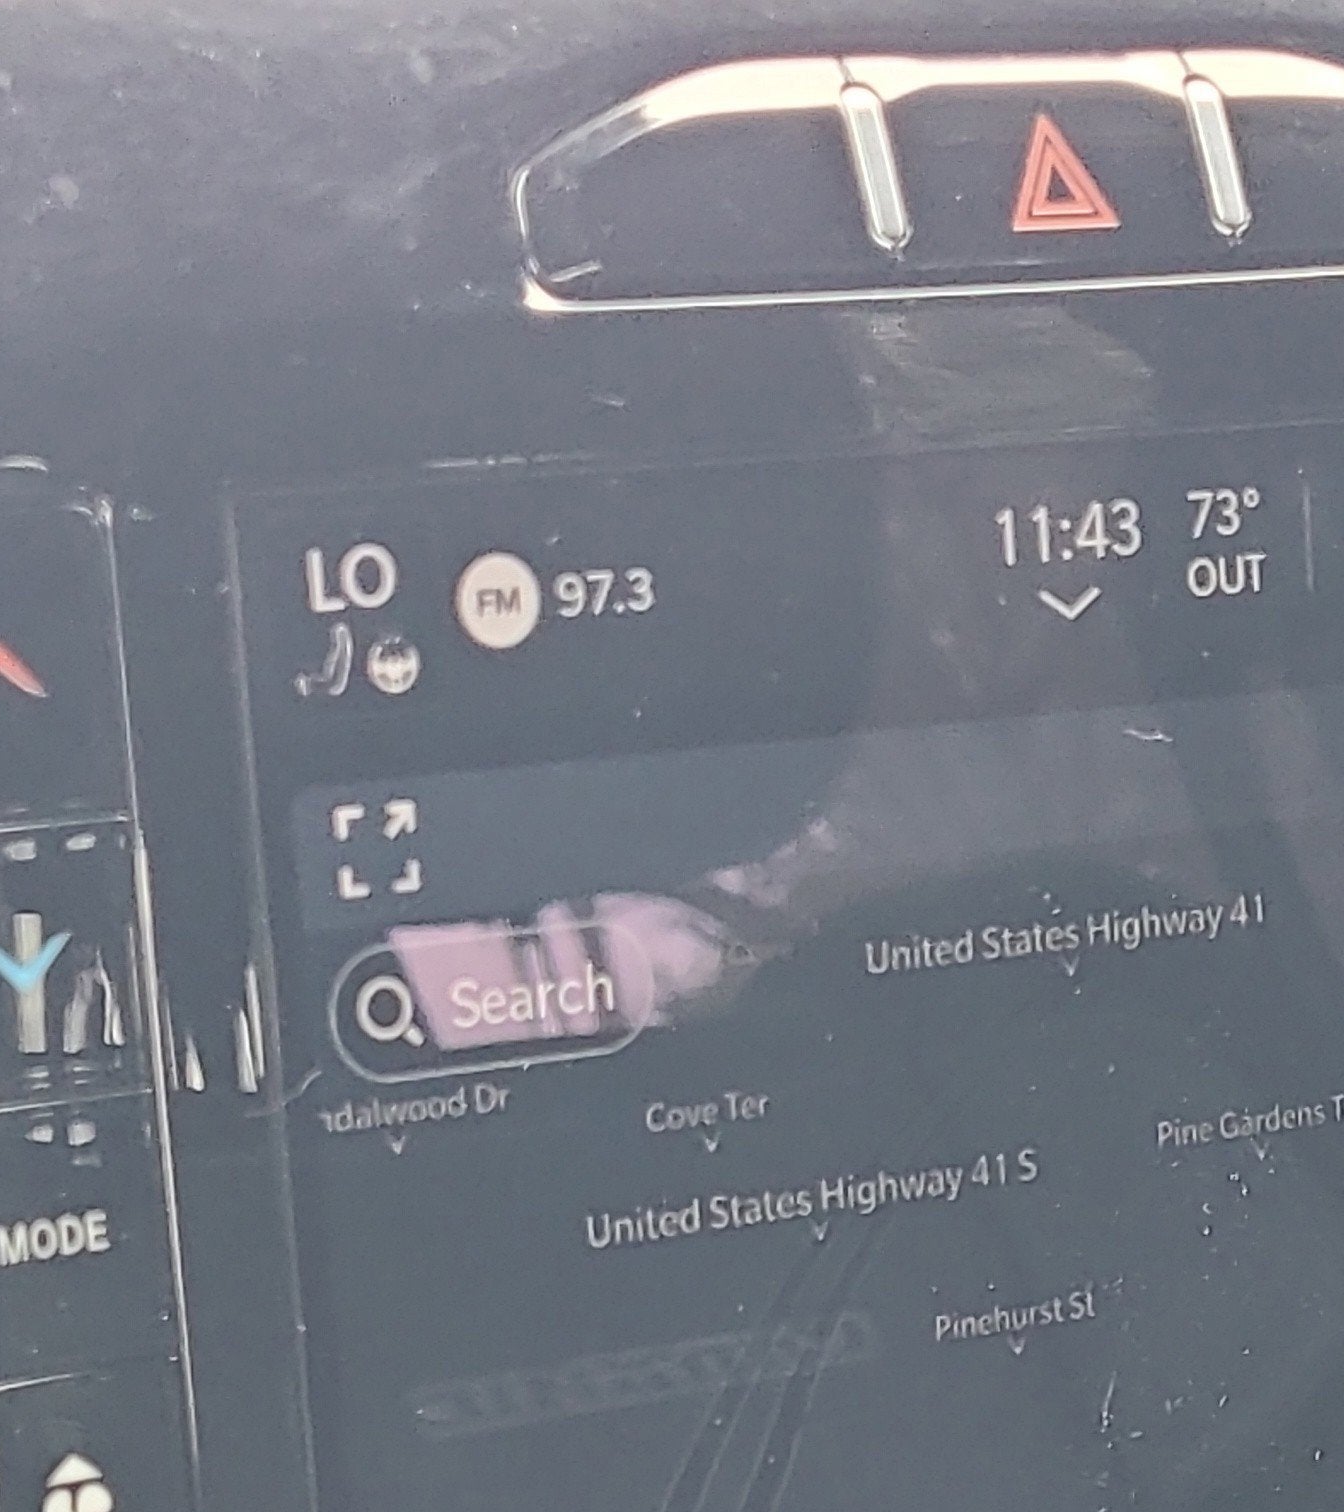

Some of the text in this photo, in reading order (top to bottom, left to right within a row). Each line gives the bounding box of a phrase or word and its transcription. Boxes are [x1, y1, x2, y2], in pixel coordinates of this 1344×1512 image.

[995, 497, 1143, 568] 11:43
[1186, 485, 1262, 540] 73°
[306, 542, 397, 614] LO
[476, 566, 656, 620] FM 97.3
[1186, 552, 1267, 598] OUT
[864, 892, 1267, 976] United States Highway 41
[450, 963, 615, 1030] Search
[474, 1082, 511, 1115] Dr
[645, 1091, 772, 1135] Cove Ter
[1156, 1117, 1215, 1149] Pine
[1218, 1104, 1327, 1142] Gardens
[585, 1147, 1040, 1250] United States Highway 41 S
[934, 1290, 1097, 1343] Pinehurst St
